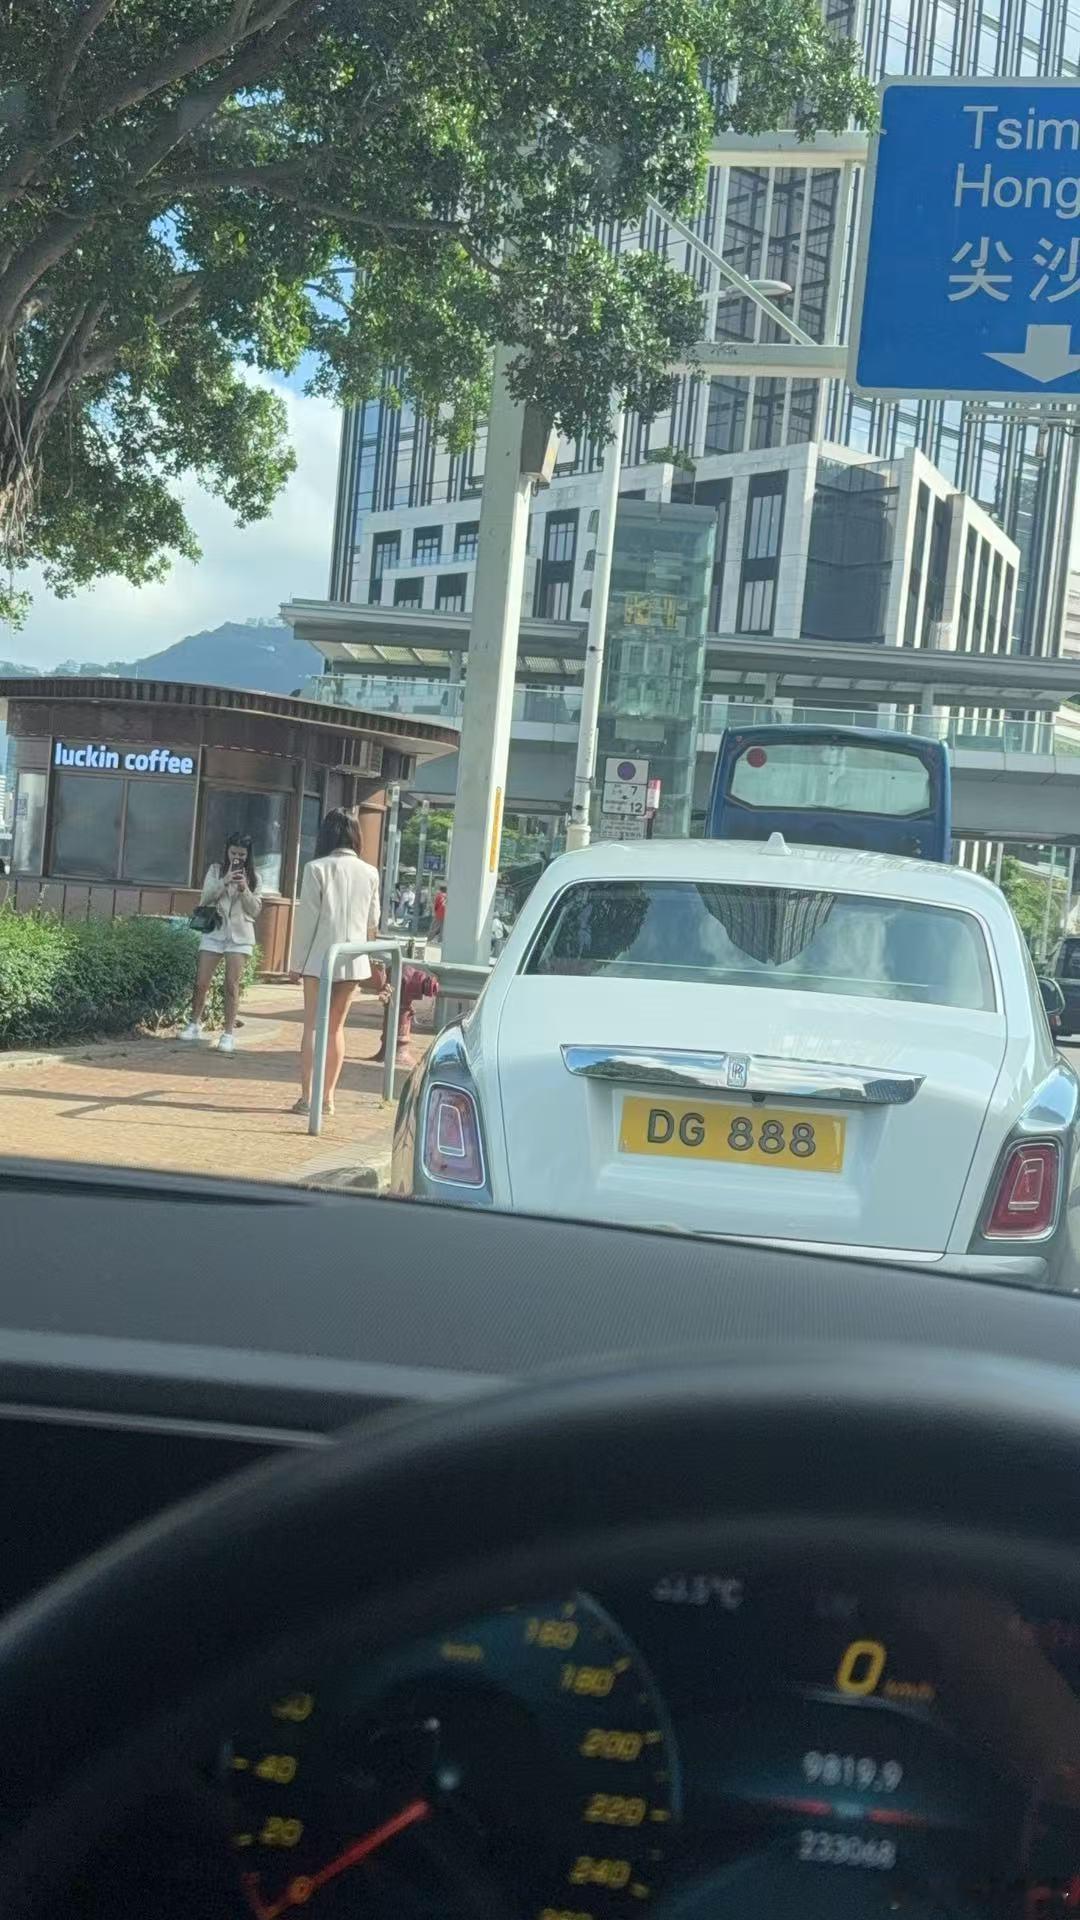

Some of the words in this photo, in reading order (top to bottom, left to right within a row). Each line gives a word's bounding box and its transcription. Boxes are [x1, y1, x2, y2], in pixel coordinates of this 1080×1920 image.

[963, 105, 1080, 150] Tsim
[954, 162, 1080, 220] Hong
[948, 236, 1080, 303] 尖沙
[54, 742, 119, 769] luckin
[124, 749, 193, 775] coffee
[630, 802, 643, 813] 12
[631, 786, 638, 795] 7
[647, 1108, 706, 1147] DG
[727, 1116, 816, 1158] 888
[835, 1639, 888, 1697] 0
